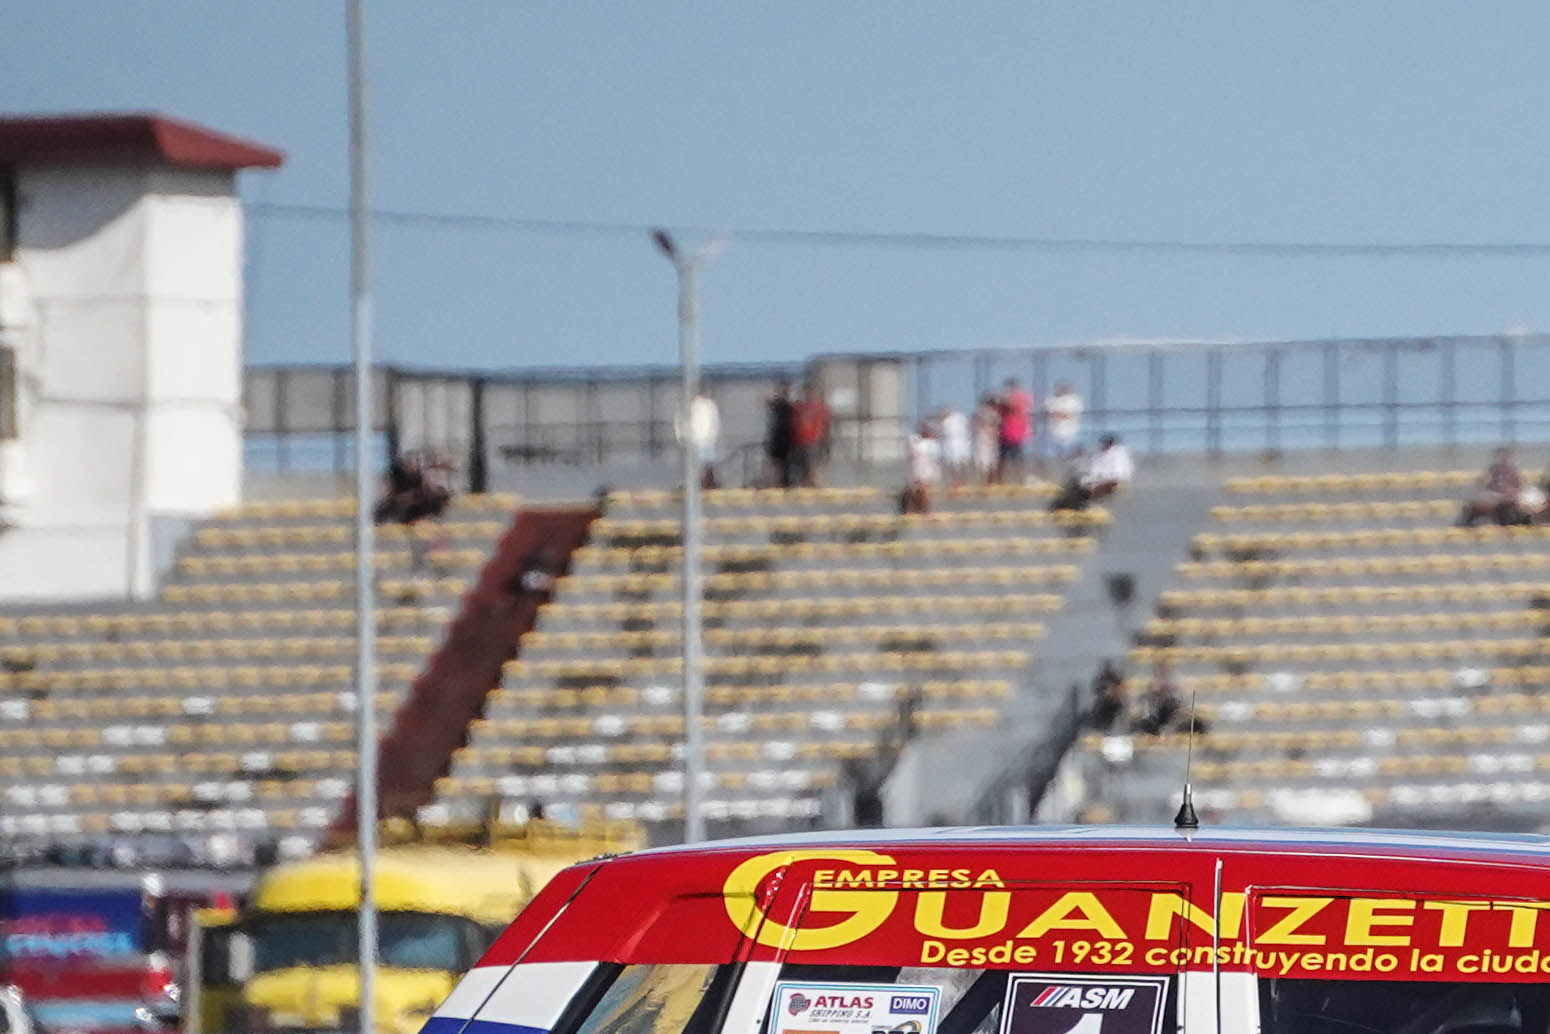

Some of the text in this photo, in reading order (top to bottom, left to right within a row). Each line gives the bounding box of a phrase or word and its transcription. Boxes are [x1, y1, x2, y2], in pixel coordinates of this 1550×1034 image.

[813, 868, 1005, 889] EMPRESA
[920, 940, 1038, 966] Desde
[1052, 941, 1134, 966] 1932
[1145, 942, 1400, 975] construyendo
[1410, 948, 1439, 973] la
[814, 995, 874, 1009] ATLAS
[892, 998, 927, 1010] DIMO
